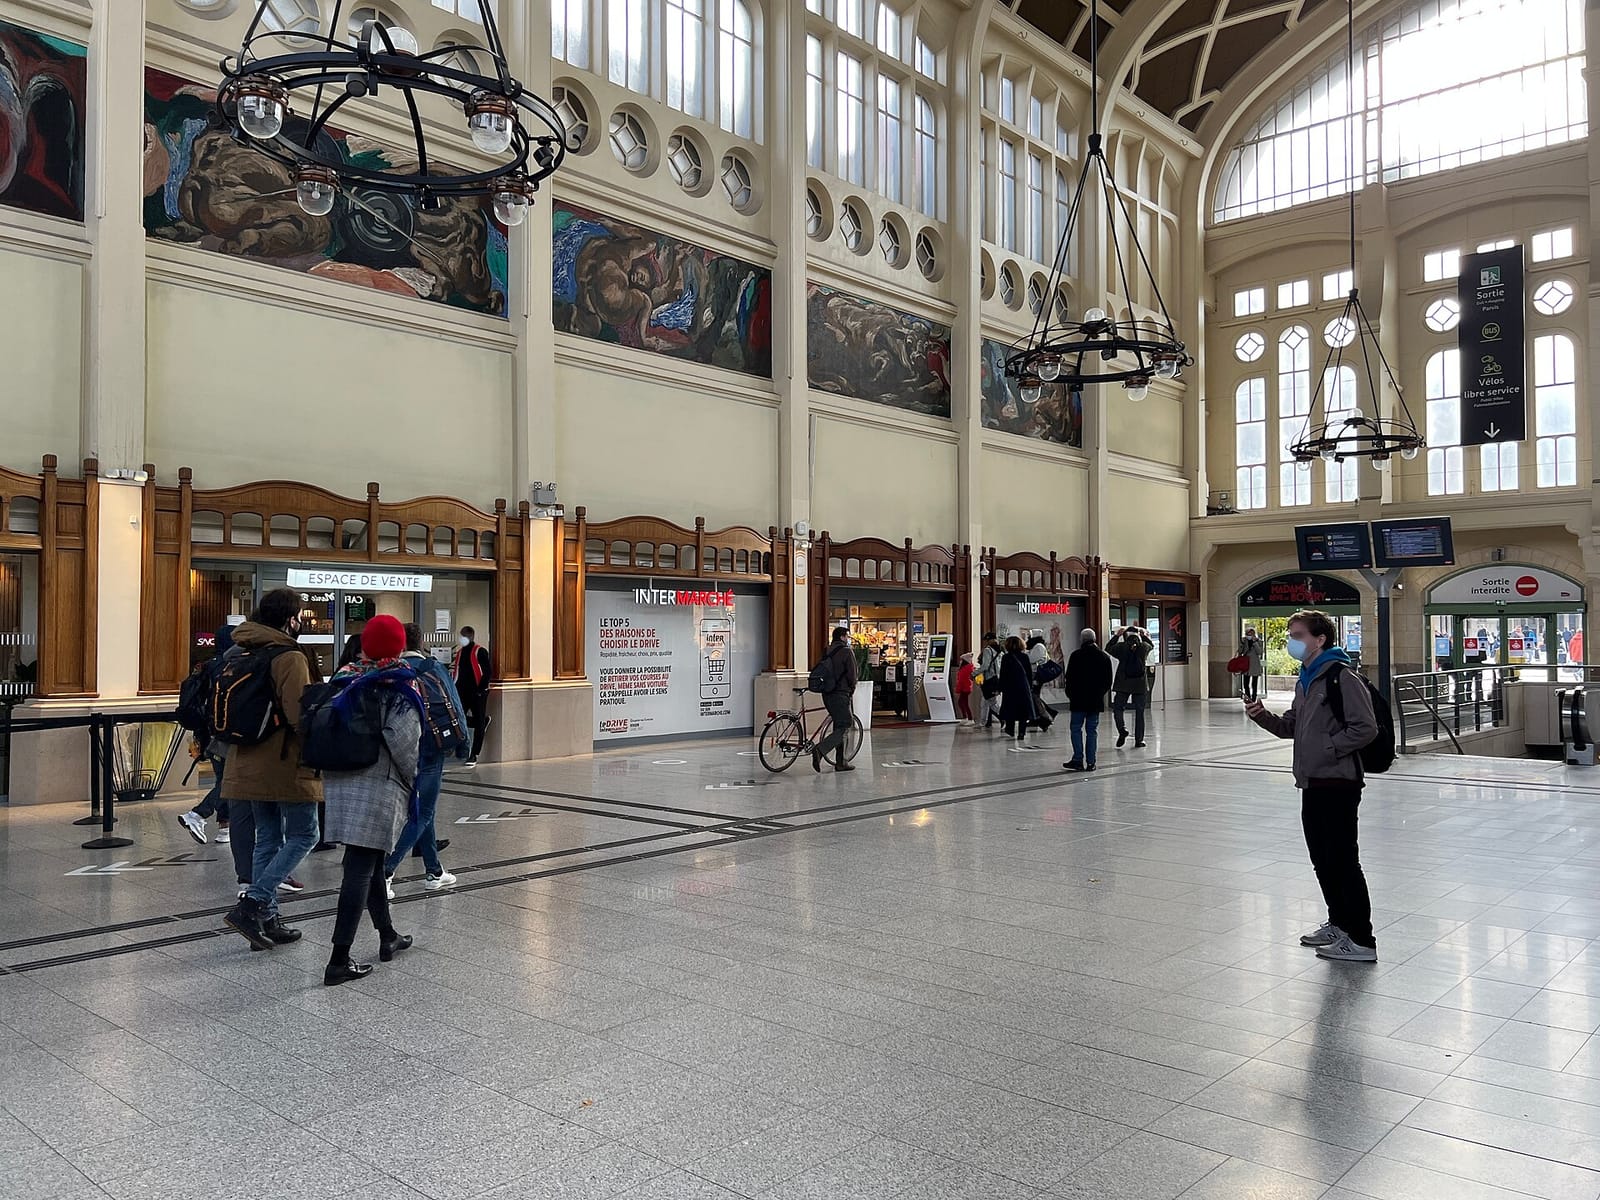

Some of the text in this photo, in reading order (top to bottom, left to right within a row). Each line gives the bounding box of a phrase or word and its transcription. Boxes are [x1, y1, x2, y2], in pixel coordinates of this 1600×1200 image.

[1476, 289, 1505, 300] Sortie
[1484, 326, 1498, 335] BUS
[1478, 377, 1505, 386] Vélos
[1463, 386, 1520, 399] libre service
[308, 573, 421, 588] ESPACE DE VENTE
[1482, 578, 1510, 586] Sortie
[1471, 586, 1511, 595] interdite
[632, 587, 736, 608] INTERMARCHÉ
[1016, 601, 1071, 615] INTERMARCHÉ
[600, 618, 630, 627] LE TOP 5
[600, 628, 656, 638] DES RAISONS DE
[600, 639, 660, 649] CHOISIR LE DRIVE
[640, 673, 661, 681] COURSES
[634, 681, 646, 689] SANS
[656, 687, 668, 695] SENS
